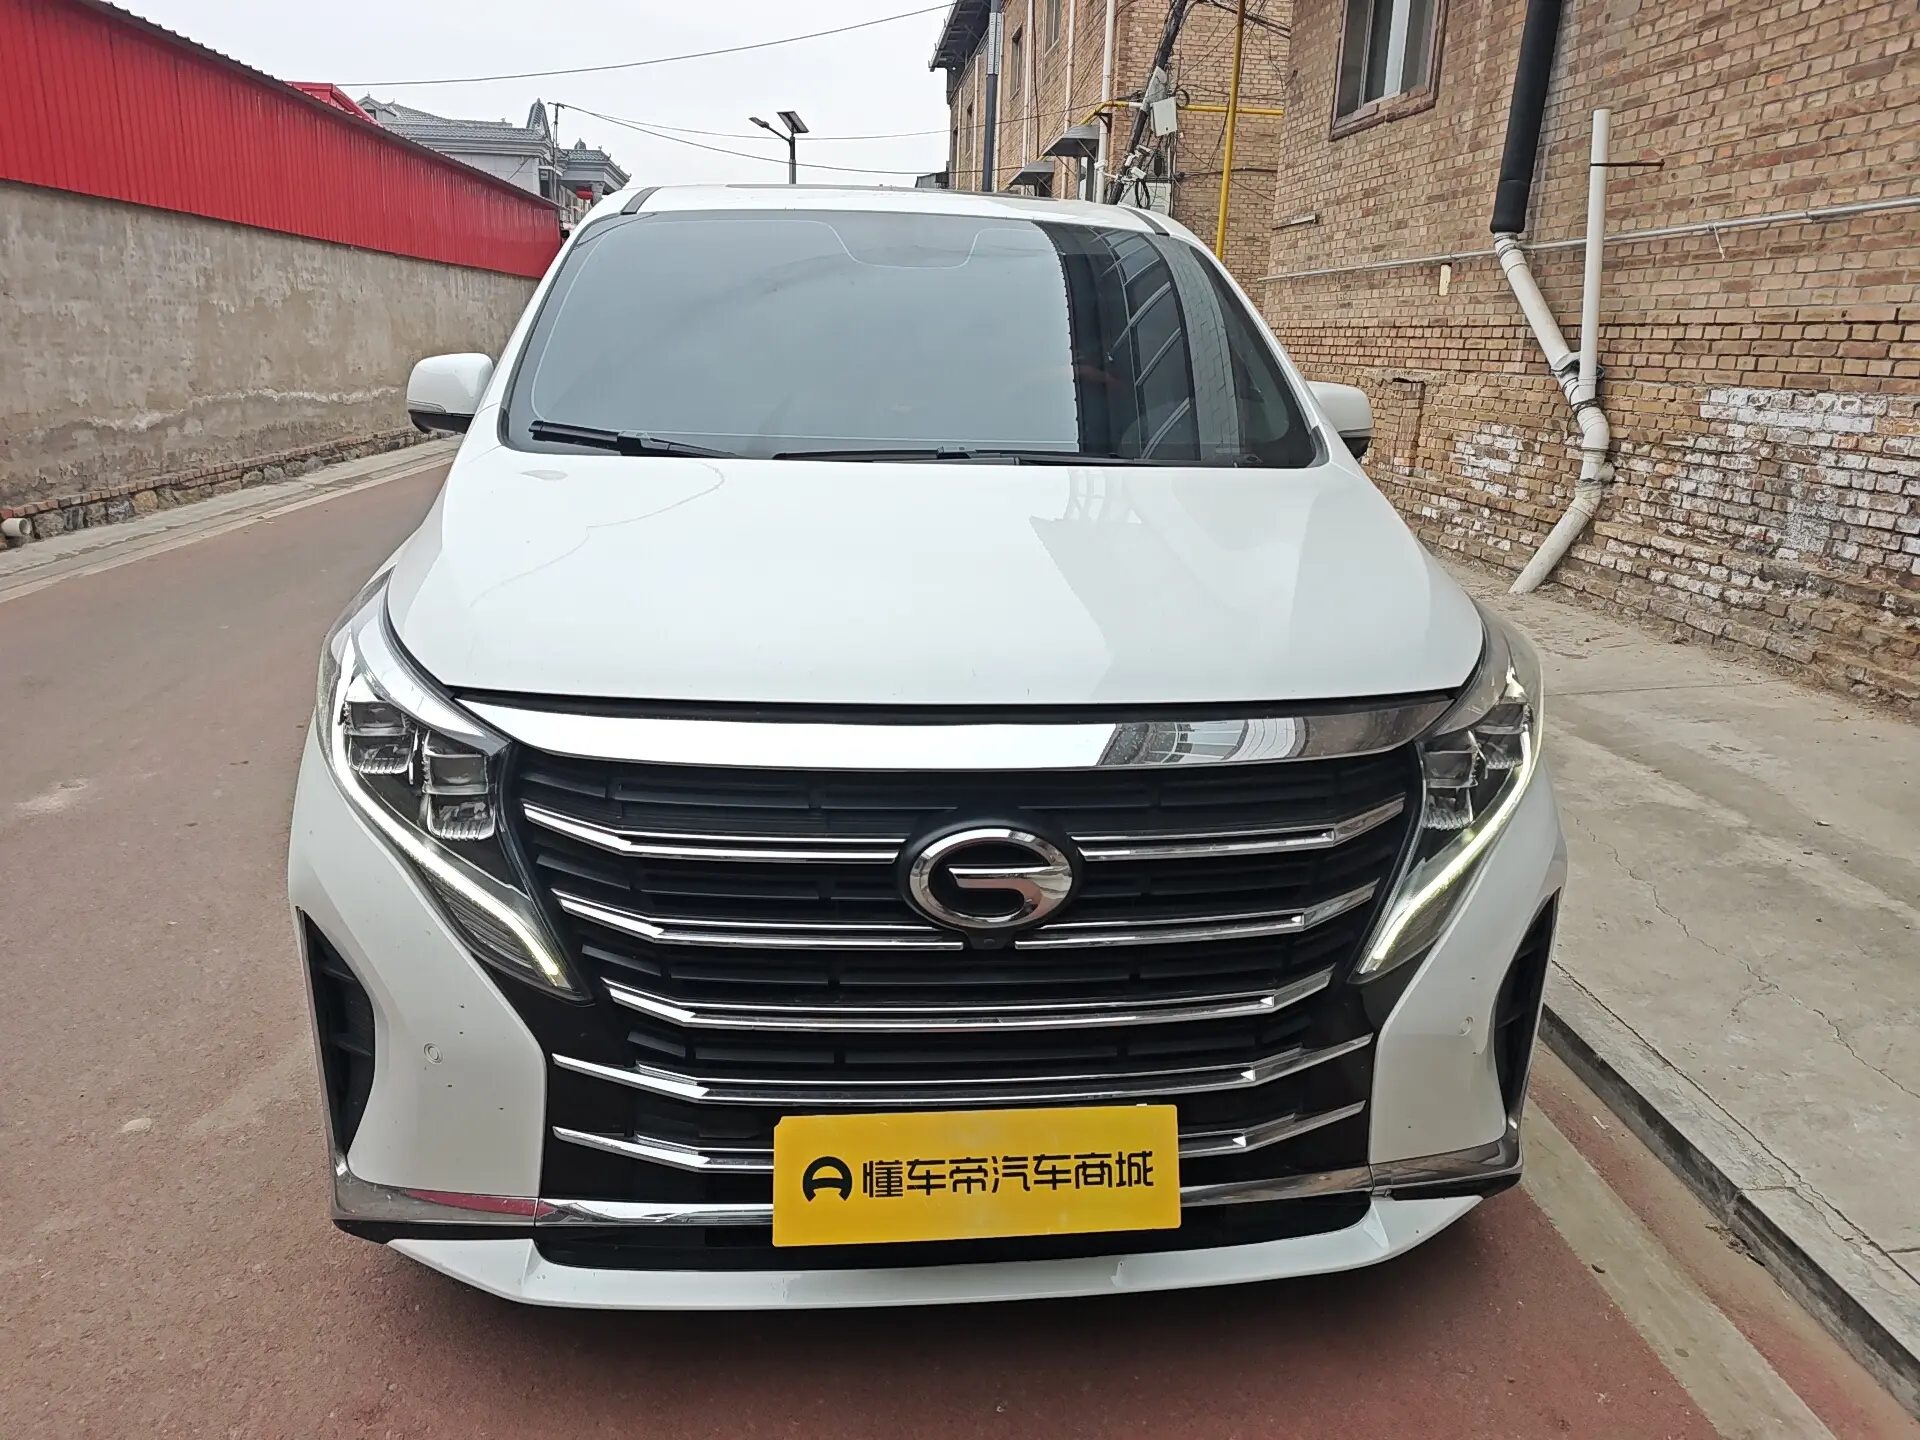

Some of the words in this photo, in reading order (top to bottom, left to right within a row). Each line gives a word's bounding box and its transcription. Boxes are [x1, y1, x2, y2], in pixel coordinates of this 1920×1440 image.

[862, 1150, 1154, 1198] 懂车帝汽车商城
